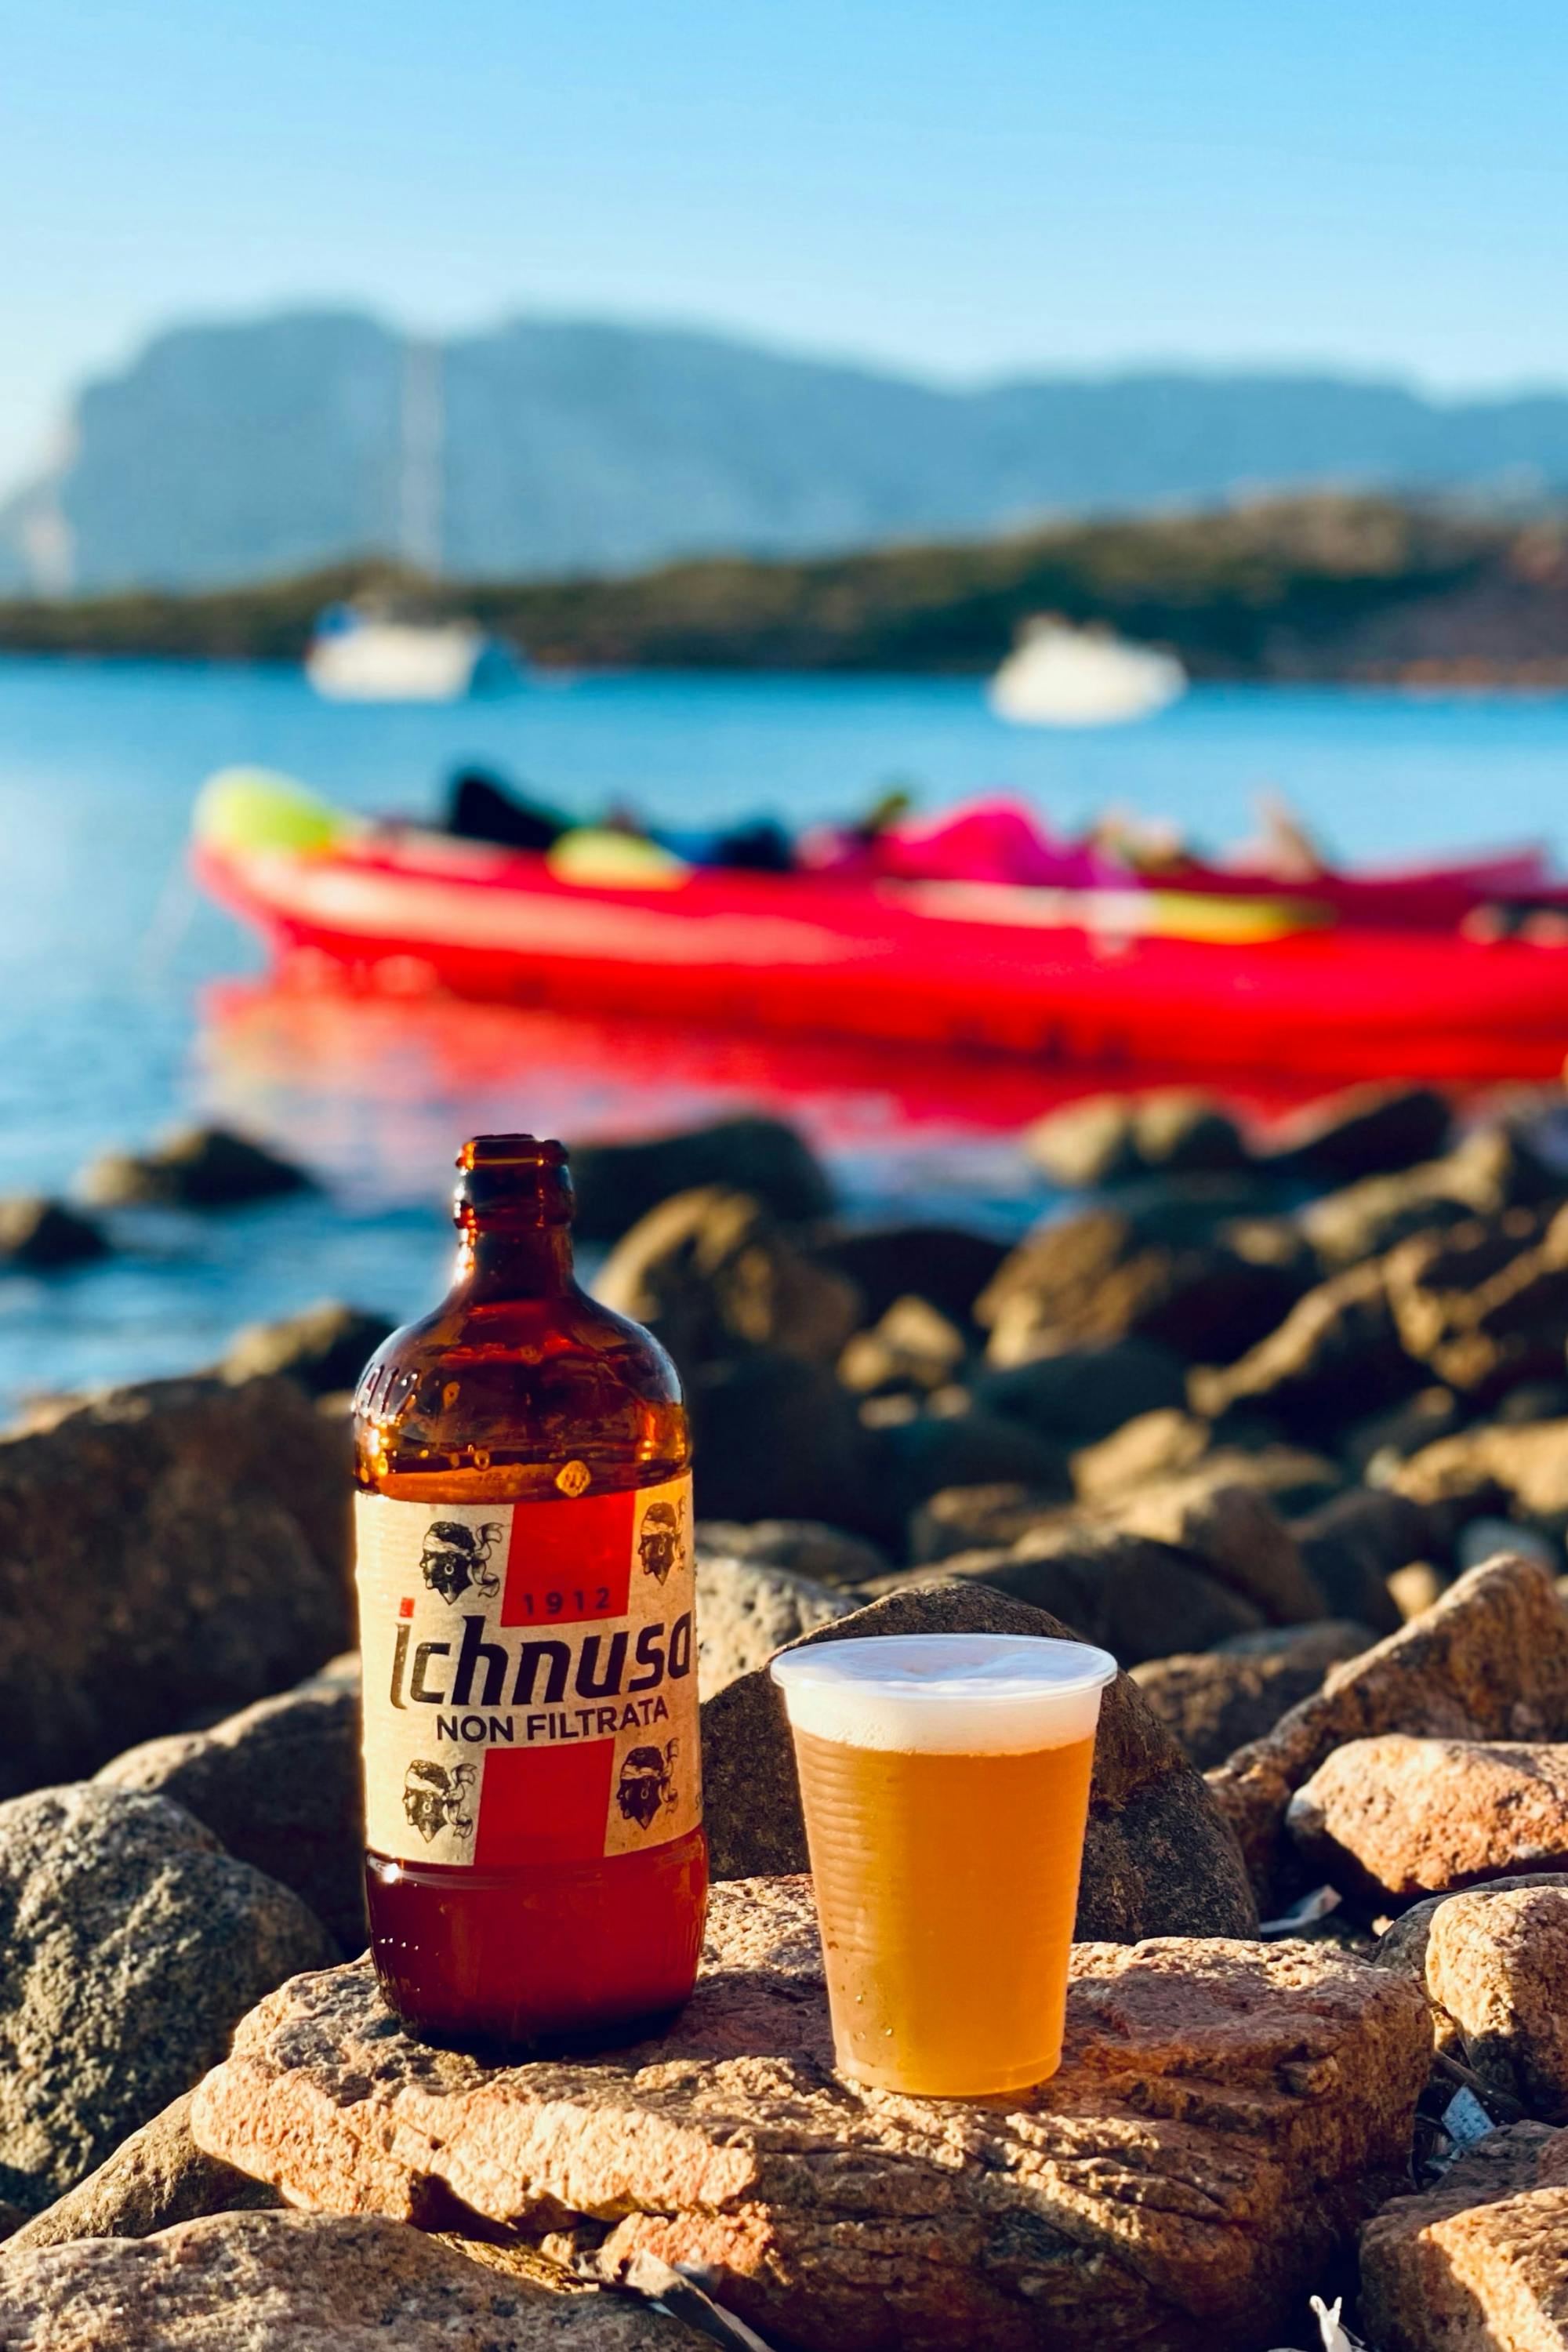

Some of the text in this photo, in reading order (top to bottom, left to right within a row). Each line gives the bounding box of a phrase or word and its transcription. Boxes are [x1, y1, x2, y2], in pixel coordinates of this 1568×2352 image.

[524, 1588, 610, 1615] 1912
[390, 1597, 691, 1709] ichnusa
[437, 1696, 669, 1743] NON FILTRATA
